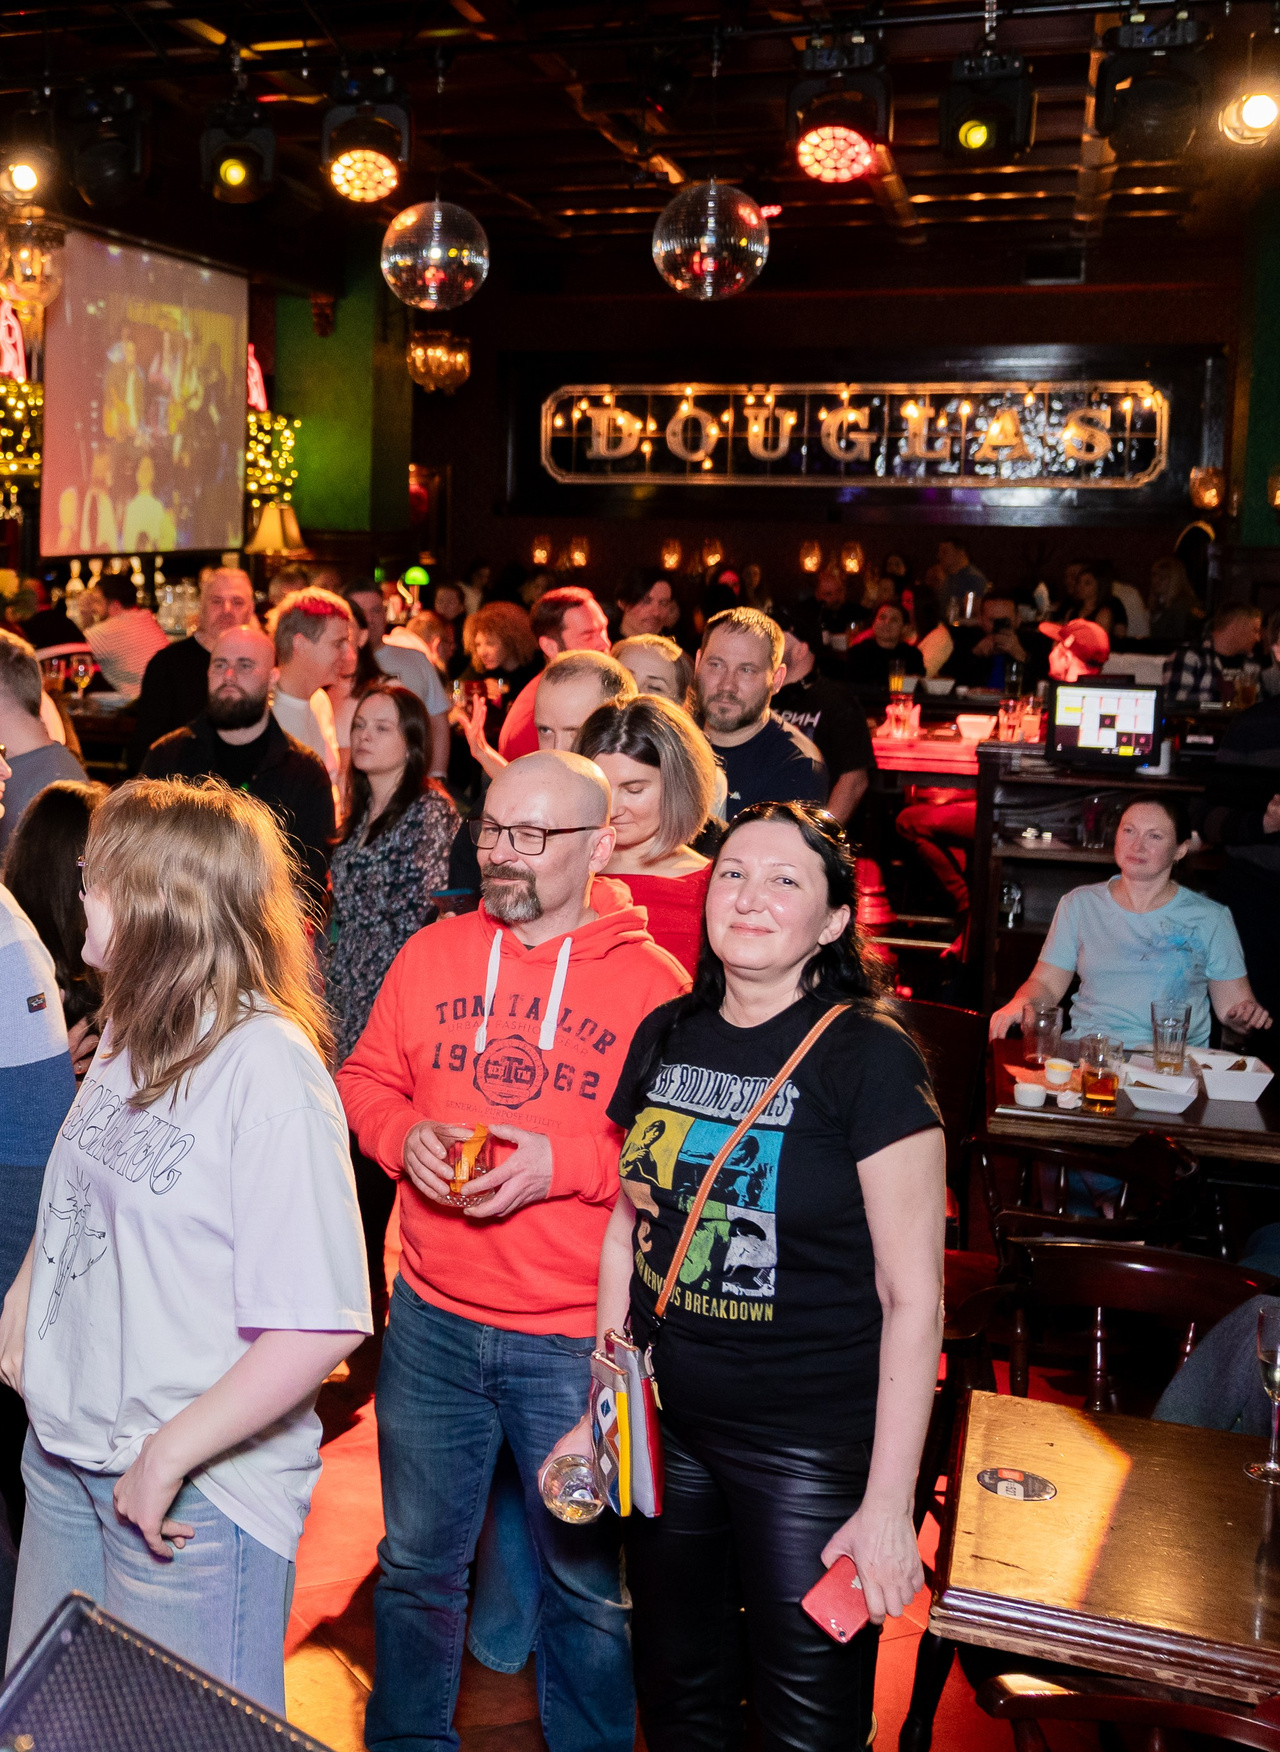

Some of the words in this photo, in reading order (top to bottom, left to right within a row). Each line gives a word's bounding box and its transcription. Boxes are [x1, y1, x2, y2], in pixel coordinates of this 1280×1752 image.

[585, 404, 1113, 463] DOUGLAS
[435, 993, 496, 1025] TOM
[508, 993, 617, 1055] TALOR
[671, 1065, 738, 1112] ROLLING
[730, 1076, 795, 1120] STOES
[684, 1290, 774, 1322] BREAKDOWN
